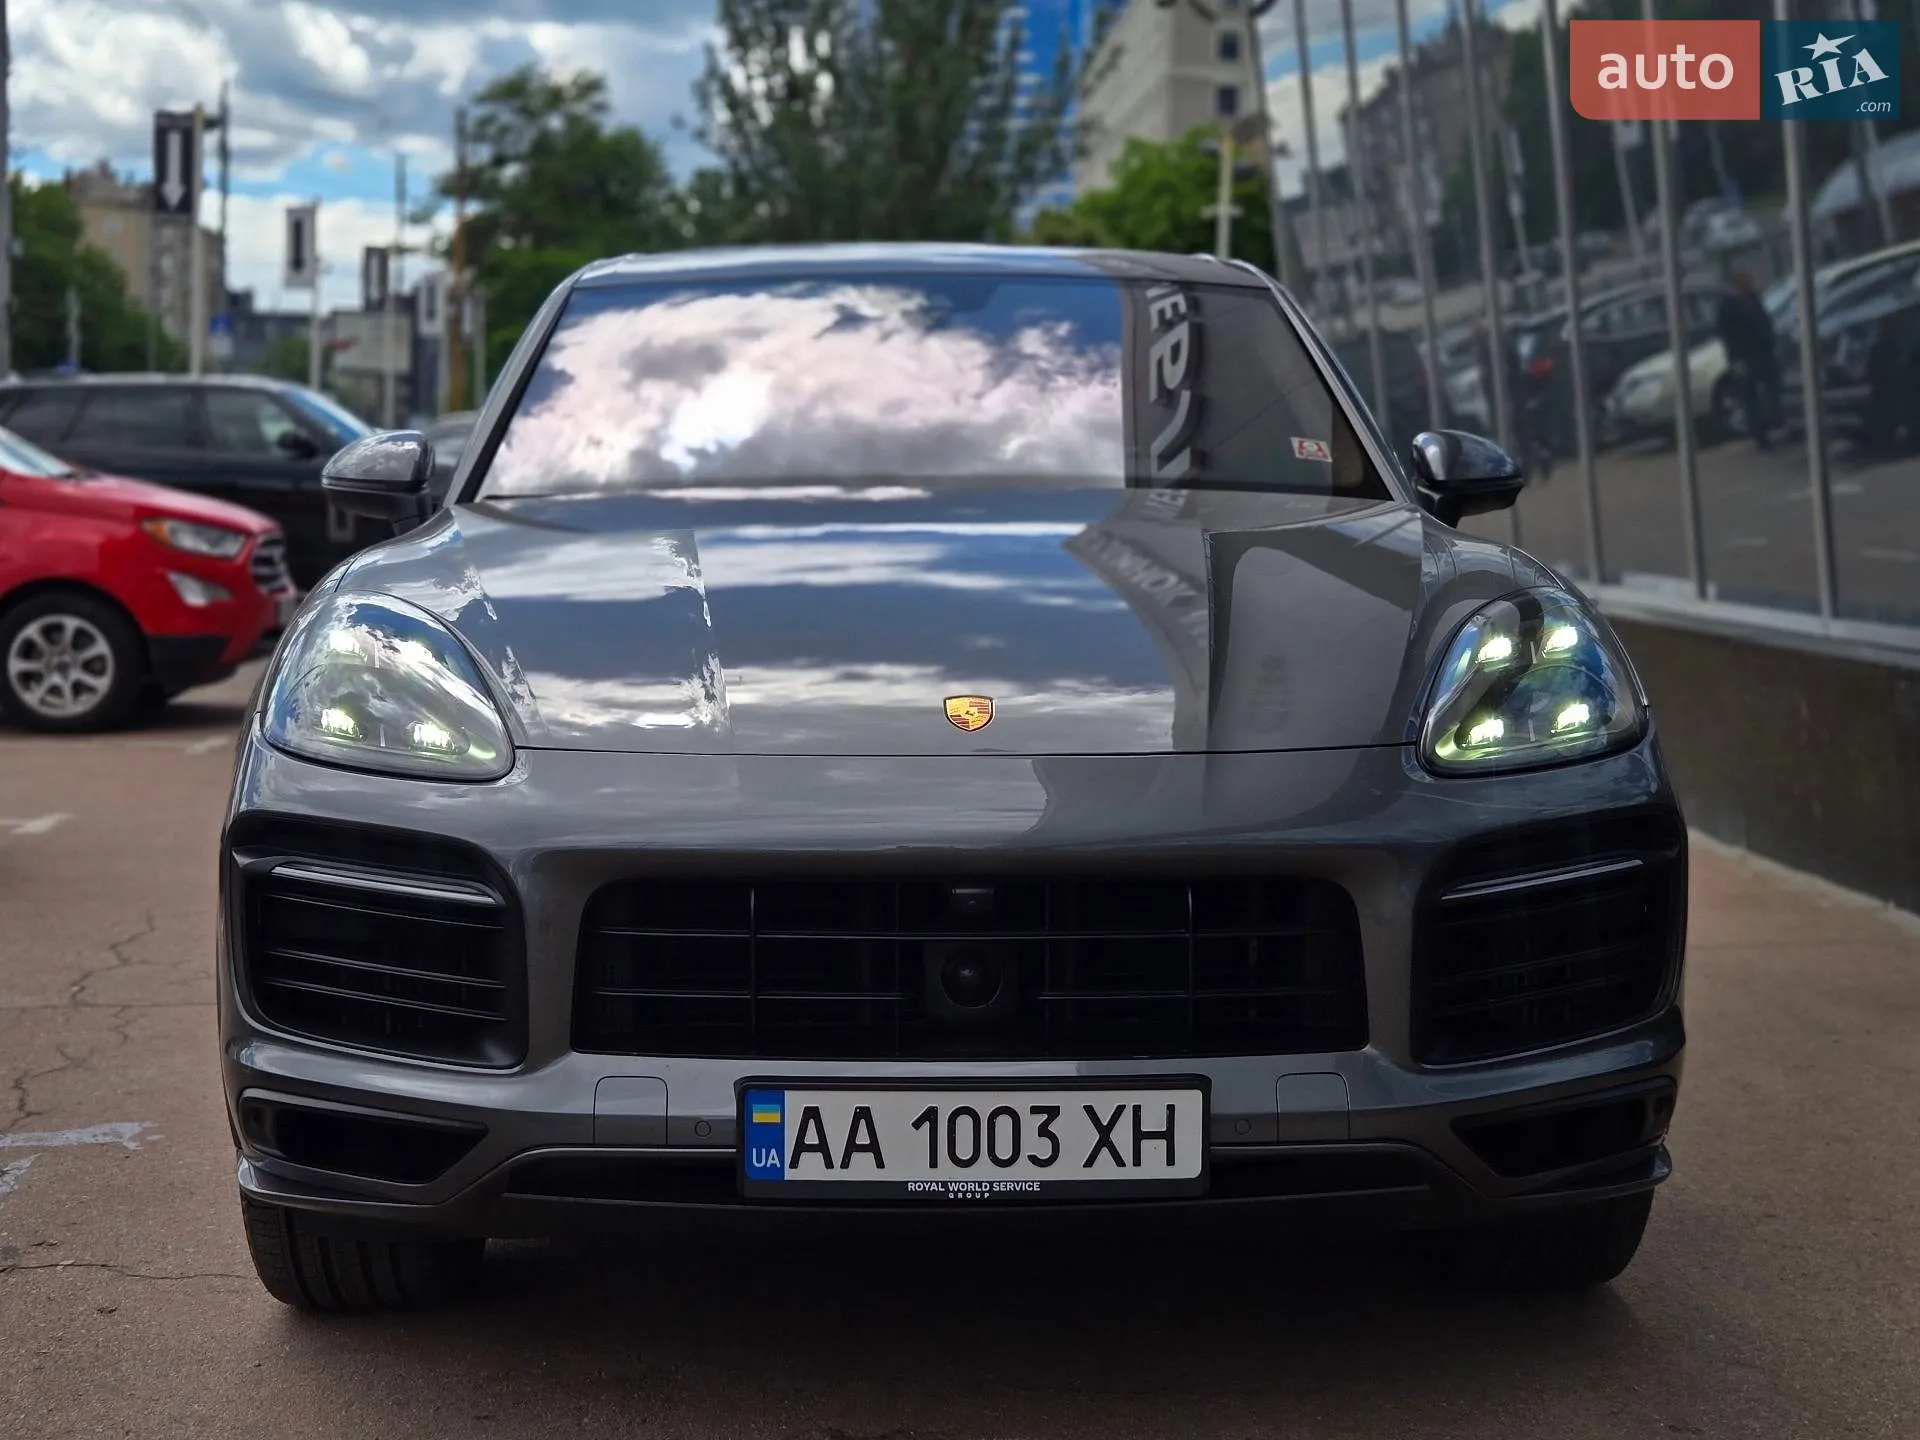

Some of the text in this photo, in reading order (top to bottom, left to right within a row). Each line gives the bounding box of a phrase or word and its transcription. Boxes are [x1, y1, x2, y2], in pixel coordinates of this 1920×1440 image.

[788, 1103, 1176, 1170] AA 1003 XH
[752, 1148, 781, 1168] UA
[907, 1181, 1041, 1192] ROYAL WORLD SERVICE
